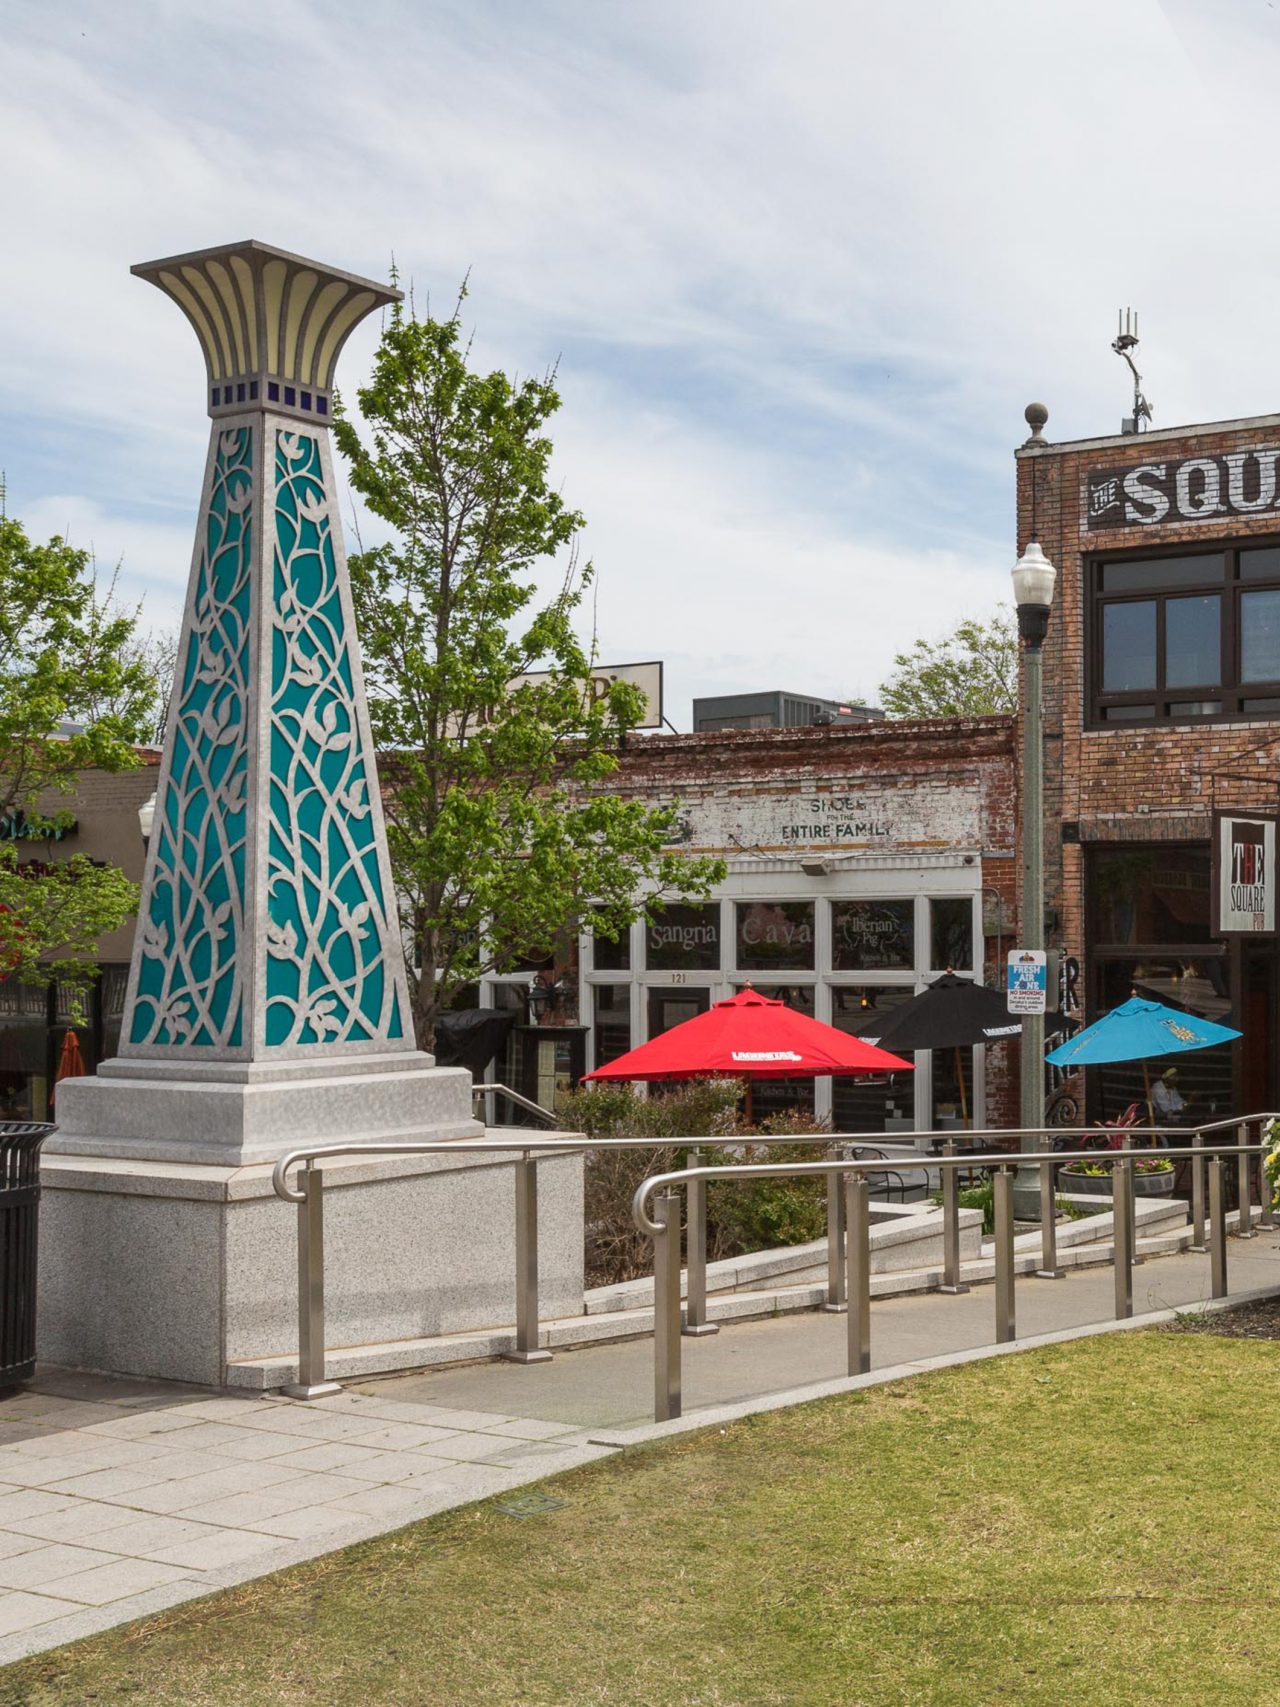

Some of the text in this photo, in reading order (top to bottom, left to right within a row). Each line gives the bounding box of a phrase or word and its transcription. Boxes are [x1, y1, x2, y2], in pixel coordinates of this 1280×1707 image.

[1091, 480, 1119, 515] THE
[782, 824, 831, 839] ENTIRE
[1232, 843, 1264, 886] THE
[1230, 885, 1265, 913] SQUARE
[852, 916, 893, 933] Iberian
[1253, 912, 1265, 931] PUB
[651, 919, 717, 951] Sangria
[742, 919, 813, 945] Cava
[862, 931, 878, 947] Pig
[671, 973, 687, 984] 121
[1013, 966, 1040, 974] FRESH
[1019, 974, 1035, 982] AIR
